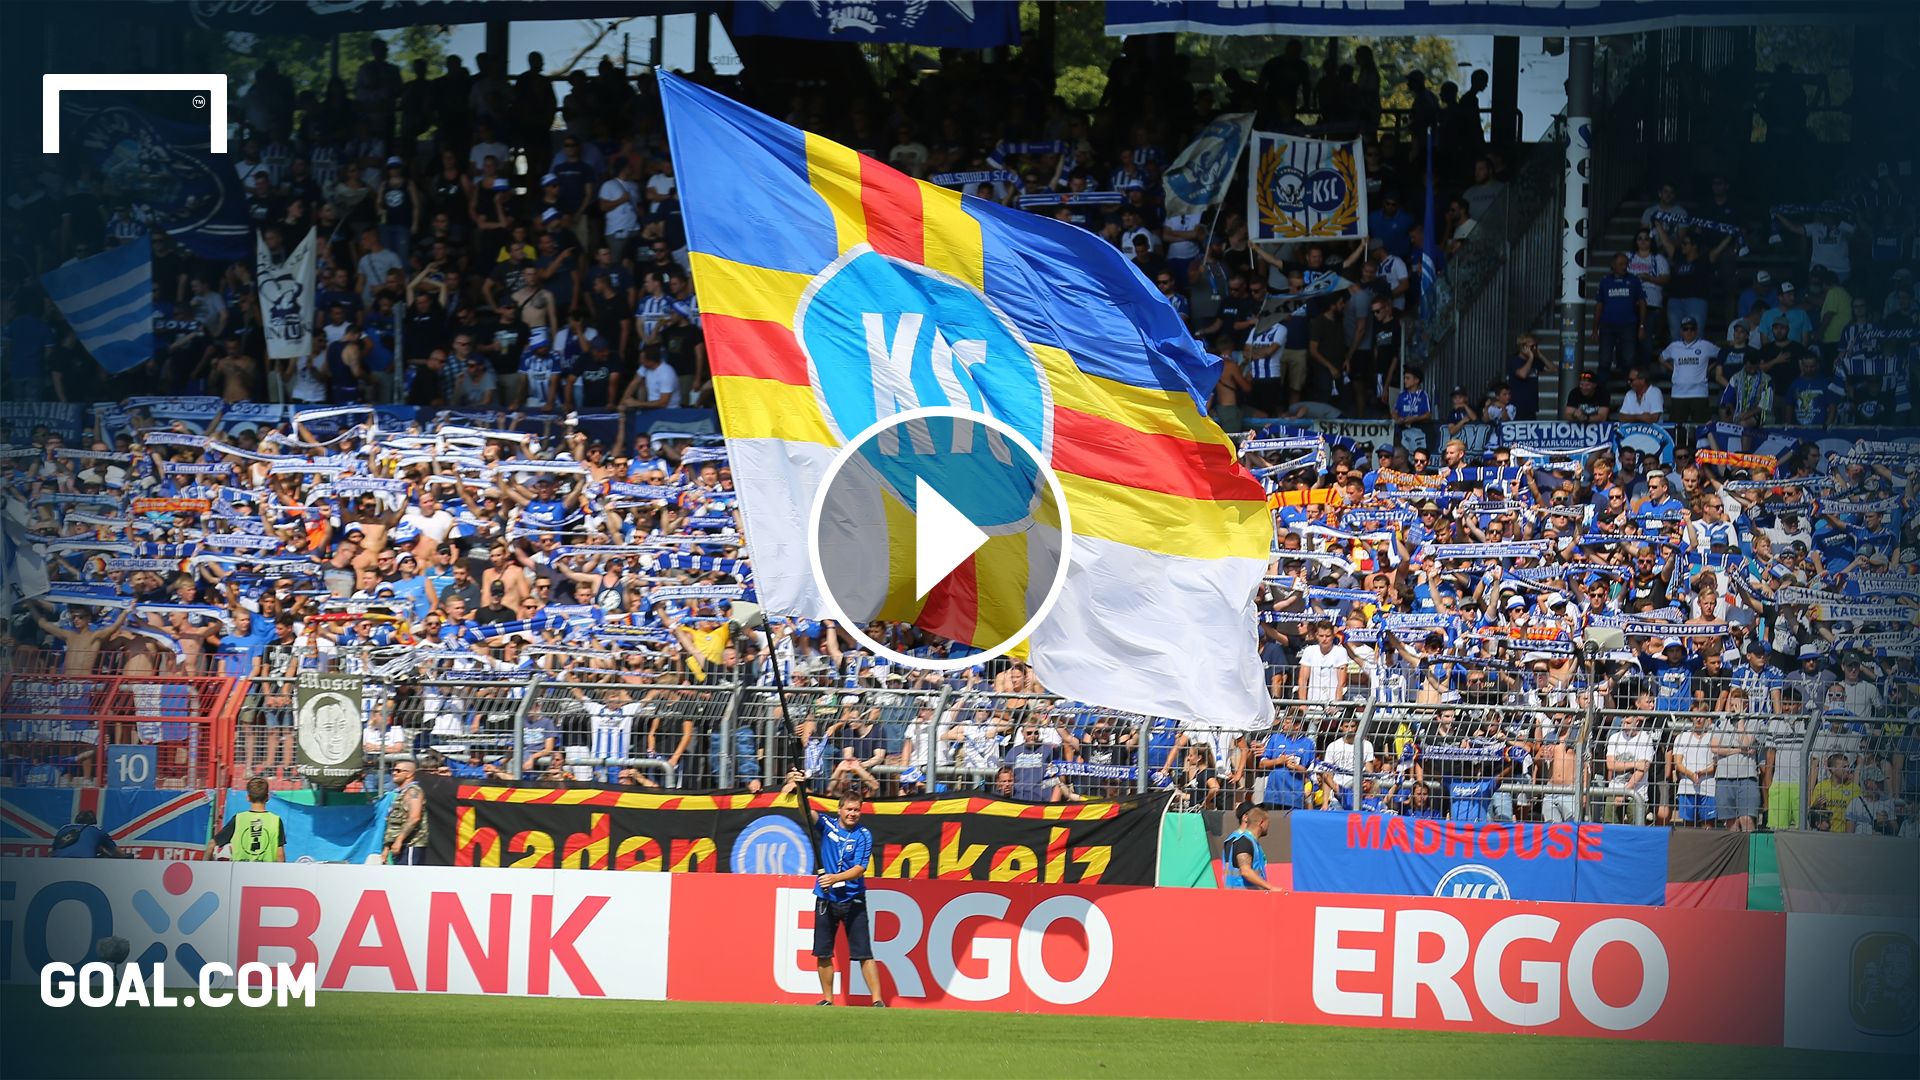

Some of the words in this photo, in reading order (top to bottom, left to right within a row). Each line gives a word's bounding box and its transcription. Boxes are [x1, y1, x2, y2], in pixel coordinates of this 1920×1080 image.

[1313, 178, 1339, 203] KSC
[1320, 422, 1390, 437] SEKTION
[1502, 423, 1585, 440] SEKTION
[1541, 440, 1585, 448] KARLSRUHE
[1829, 605, 1911, 618] KARLSRUHE
[299, 673, 359, 690] Moser
[115, 754, 149, 783] 10
[1346, 813, 1604, 861] MADHOUSE
[236, 886, 611, 997] BANK
[773, 887, 1113, 1005] ERGO
[1311, 906, 1670, 1031] ERGO
